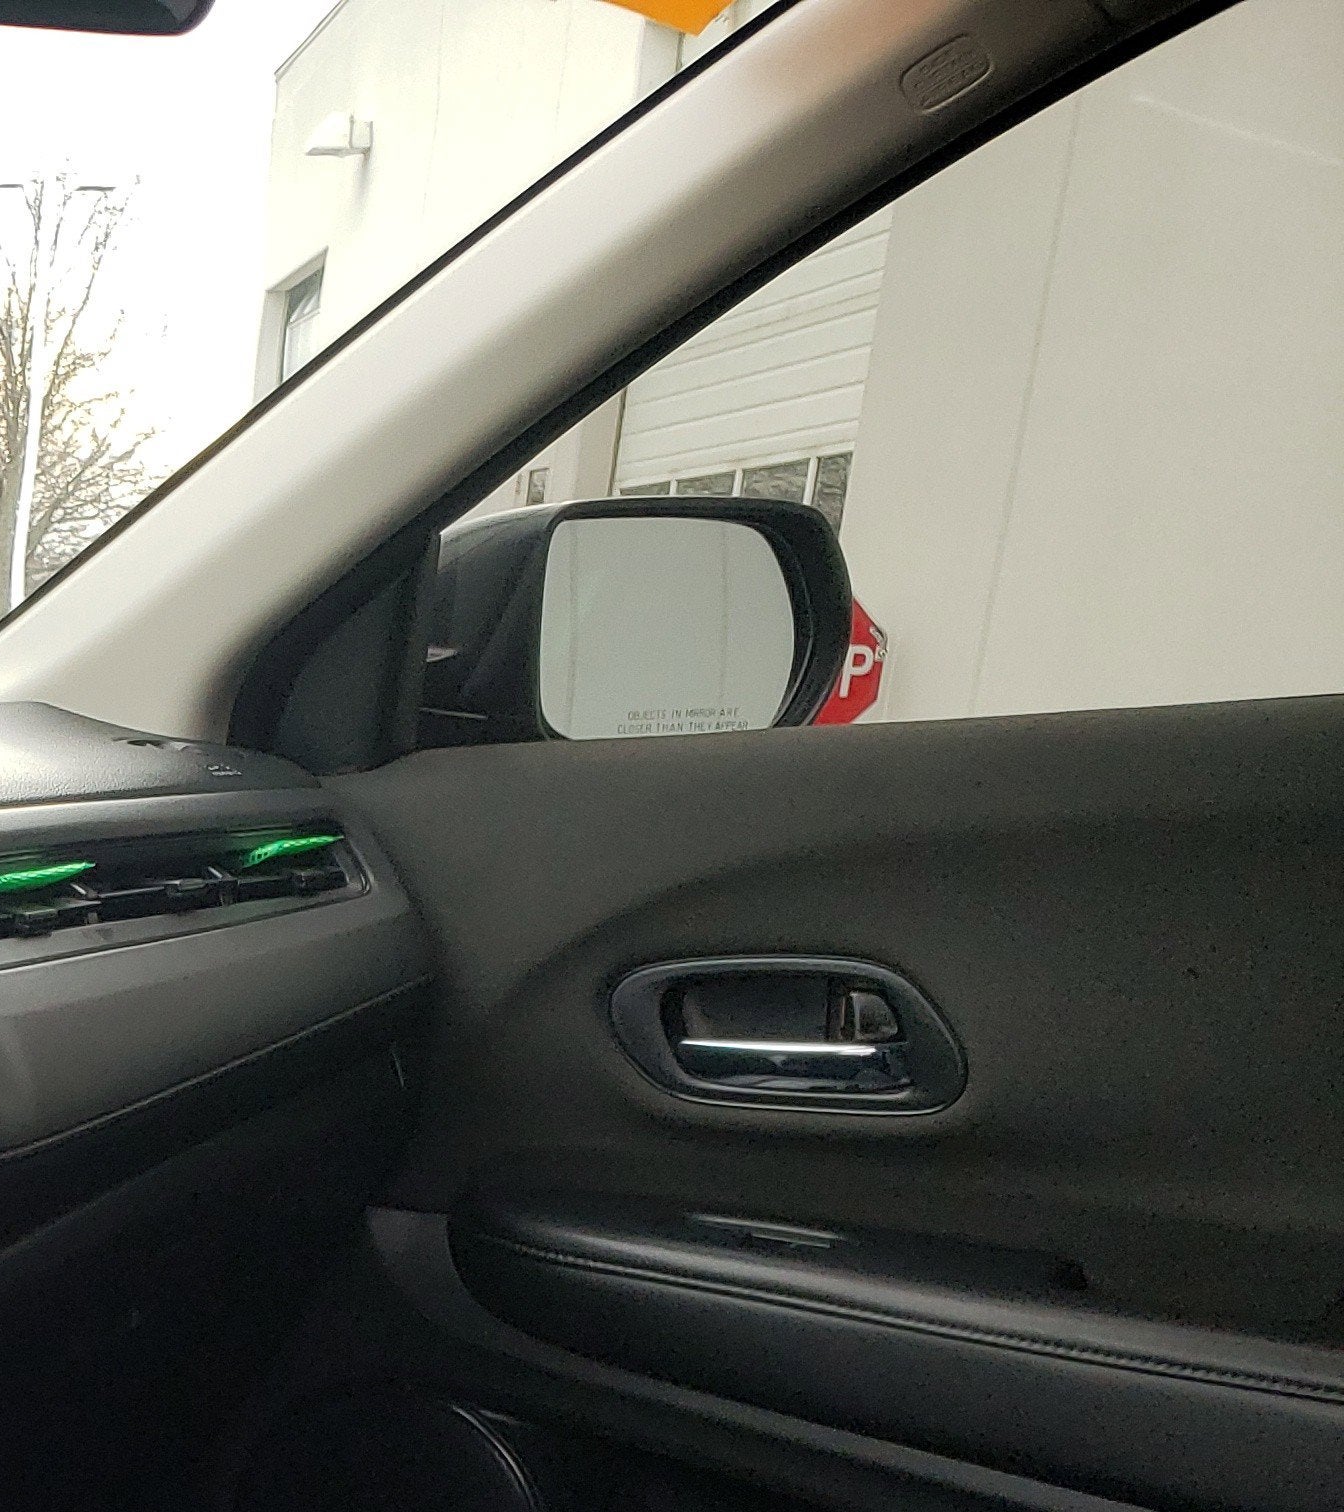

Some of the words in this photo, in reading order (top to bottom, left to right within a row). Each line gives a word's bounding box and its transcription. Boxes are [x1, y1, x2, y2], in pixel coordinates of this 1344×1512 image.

[628, 709, 666, 721] OBJECTS
[672, 709, 681, 719] IN
[686, 708, 715, 719] MIRROR
[720, 707, 739, 718] ARE
[618, 723, 652, 735] CLOSER
[656, 722, 682, 733] THAN
[689, 721, 712, 732] THEY
[715, 720, 748, 731] APPEAR
